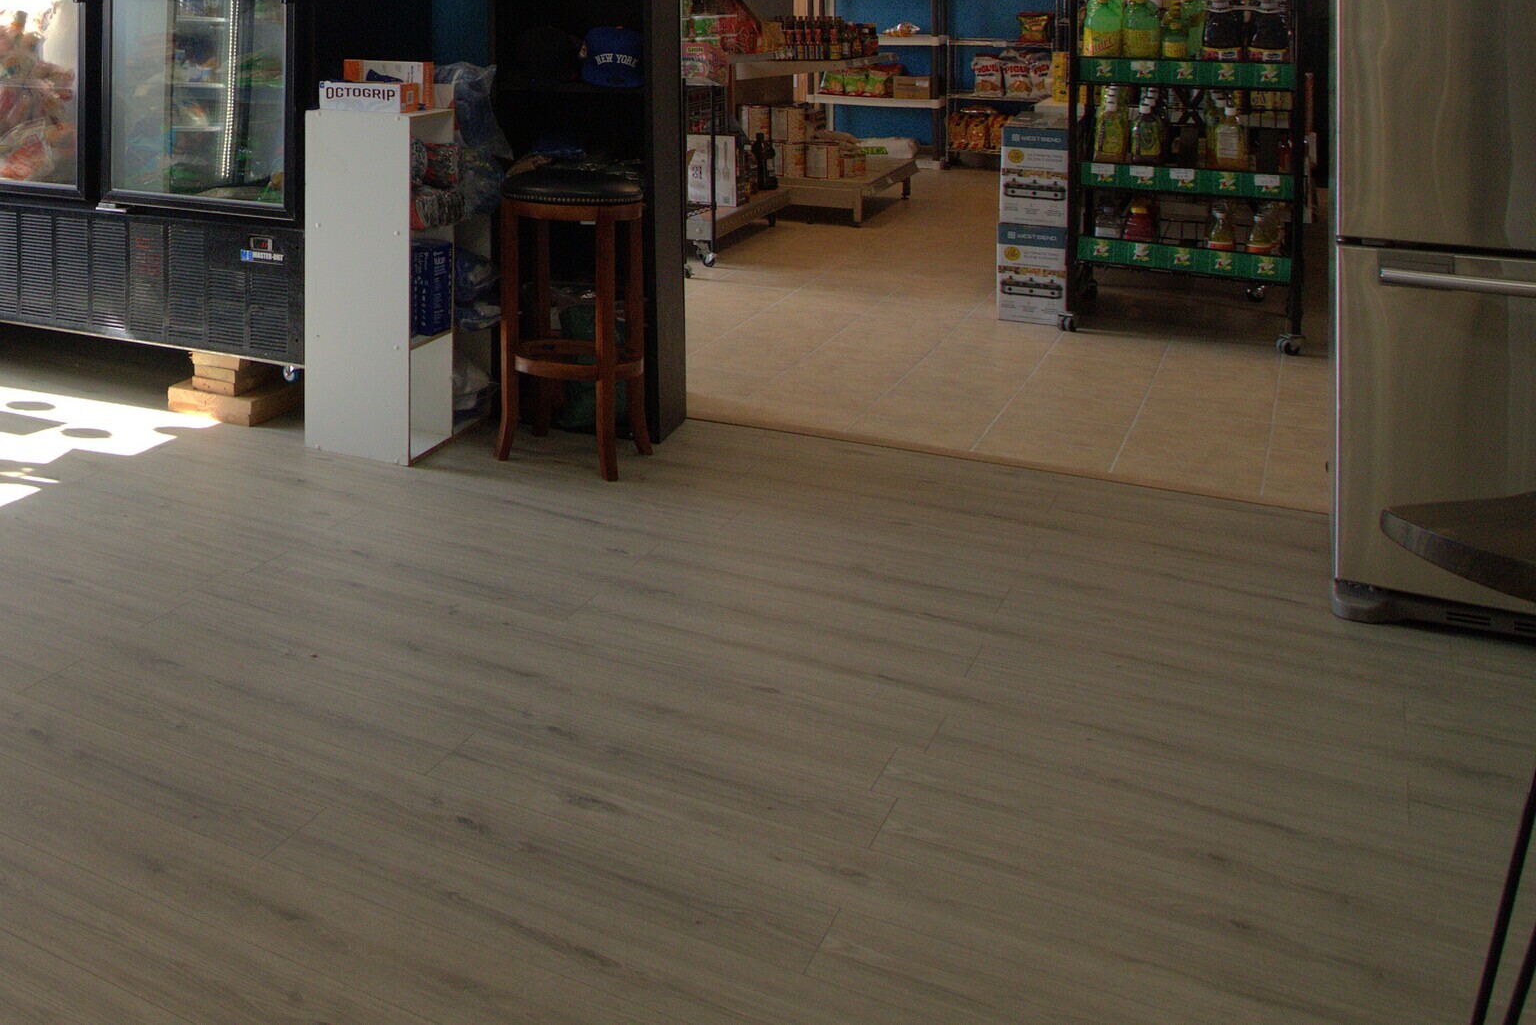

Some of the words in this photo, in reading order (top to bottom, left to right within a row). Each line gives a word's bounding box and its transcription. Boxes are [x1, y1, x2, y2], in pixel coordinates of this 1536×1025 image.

[594, 53, 613, 66] NEW
[615, 54, 639, 68] YORK
[325, 86, 396, 101] OCTOGRIP
